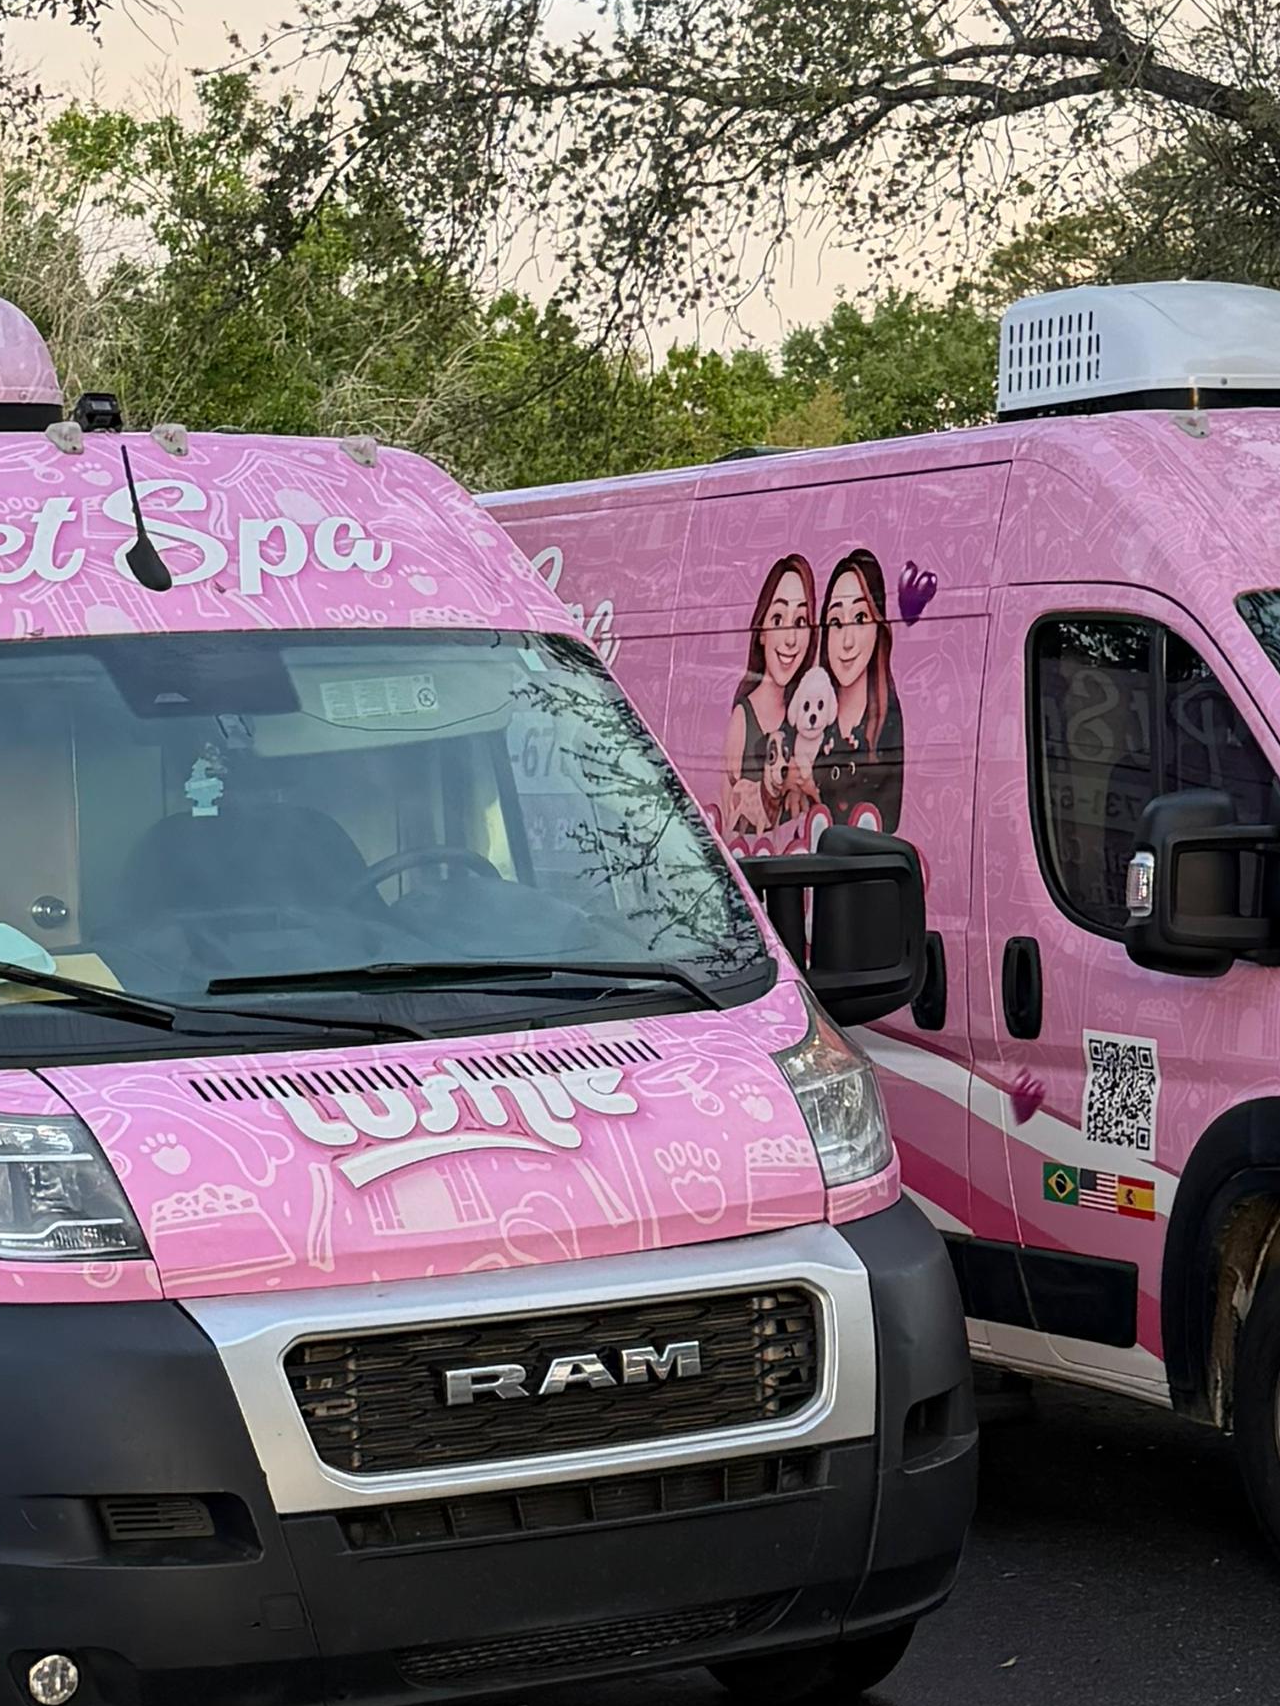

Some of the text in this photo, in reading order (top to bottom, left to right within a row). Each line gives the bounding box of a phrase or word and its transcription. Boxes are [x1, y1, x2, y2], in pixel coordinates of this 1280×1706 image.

[102, 478, 393, 595] Spa
[267, 1054, 639, 1149] Lushie
[444, 1340, 704, 1407] RAM
